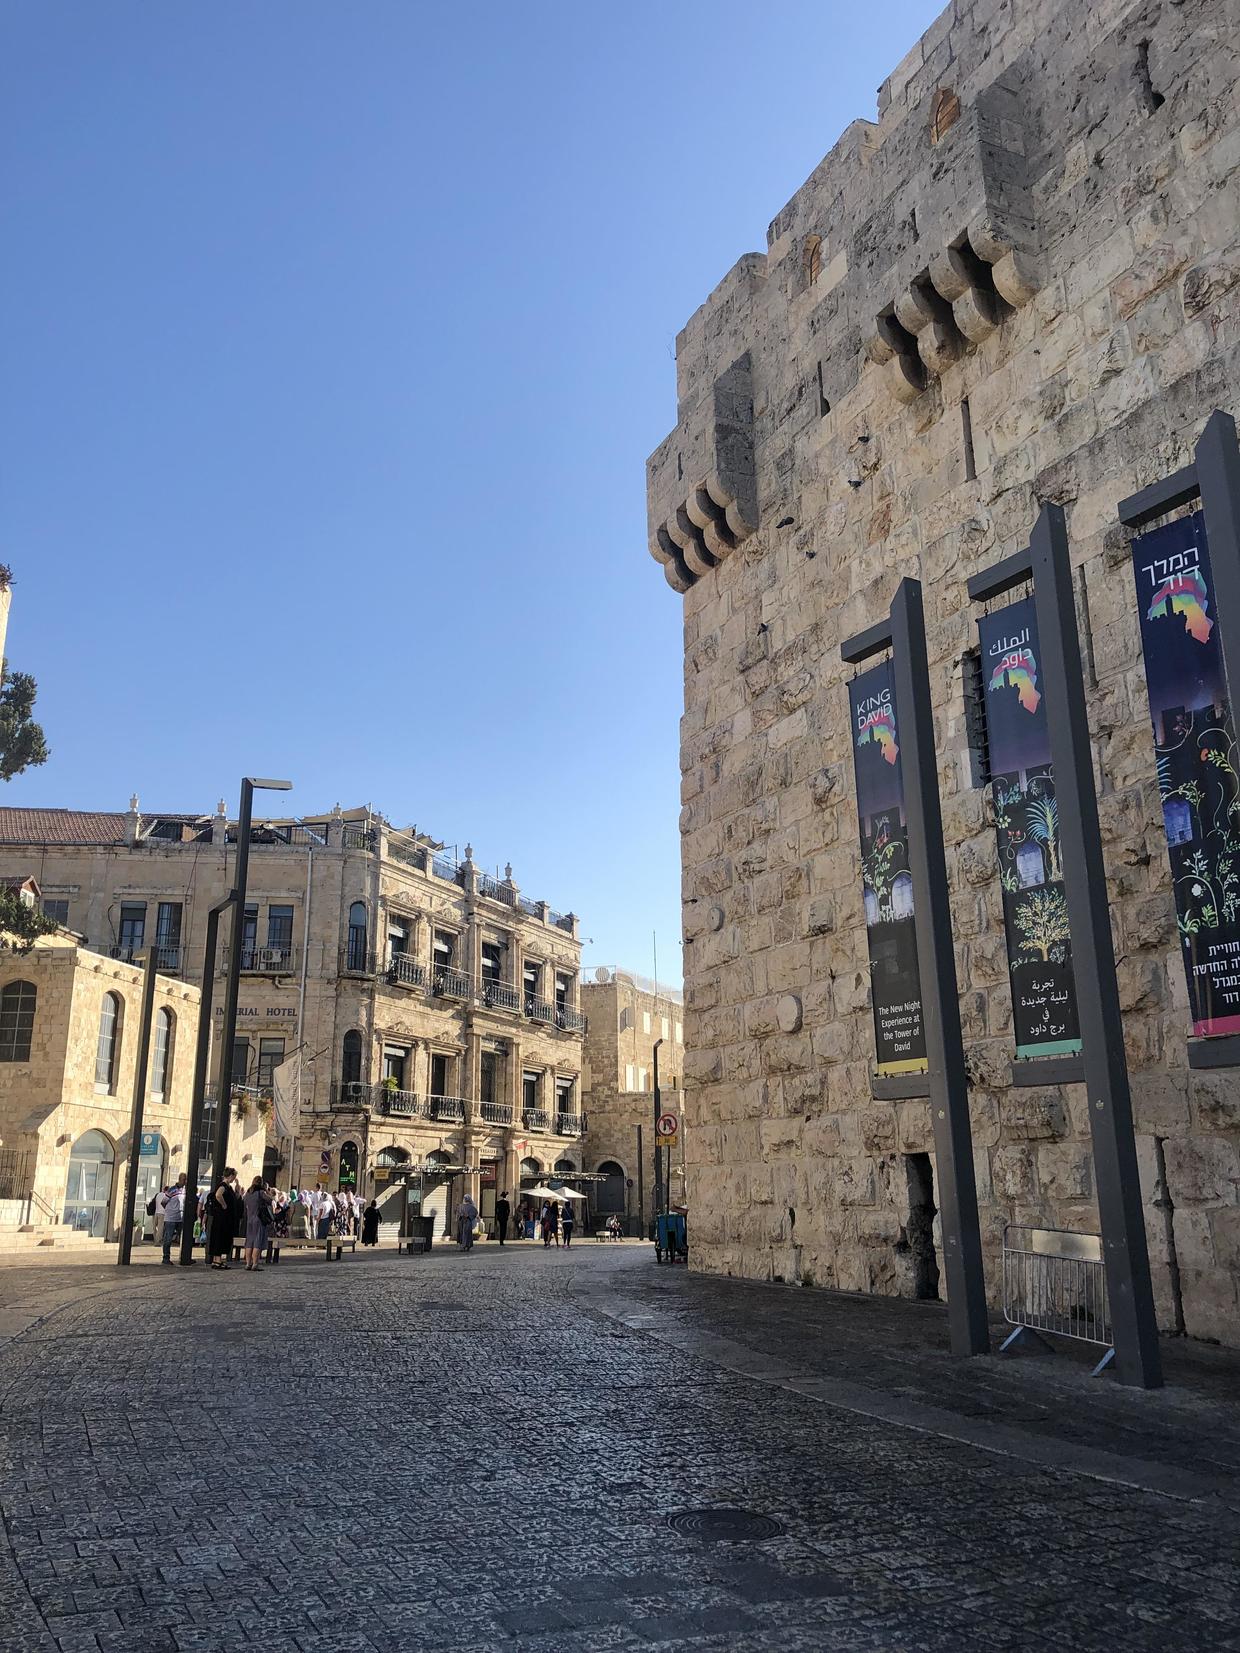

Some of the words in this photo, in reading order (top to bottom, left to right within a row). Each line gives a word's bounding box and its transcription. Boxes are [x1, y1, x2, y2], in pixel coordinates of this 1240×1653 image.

[1142, 547, 1199, 586] המלך
[1157, 565, 1200, 590] דוד
[989, 628, 1030, 656] الملك
[1001, 648, 1032, 668] داود
[857, 688, 891, 716] KING
[858, 703, 892, 729] DAVID
[1193, 960, 1227, 977] החדשה
[1032, 979, 1054, 992] تجربة
[1021, 996, 1047, 1007] جديدة
[1050, 990, 1068, 1003] ليلية
[1222, 991, 1239, 1004] דוד
[266, 1008, 298, 1016] HOTEL
[879, 1007, 889, 1016] The
[890, 1005, 903, 1013] New
[904, 1001, 921, 1012] Night
[1042, 1007, 1050, 1022] في
[881, 1017, 912, 1029] Experience
[913, 1014, 920, 1023] at
[1030, 1023, 1047, 1035] داود
[1049, 1023, 1065, 1035] برج
[883, 1031, 894, 1040] the
[894, 1029, 912, 1039] Tower
[913, 1027, 920, 1036] of
[894, 1042, 911, 1052] David
